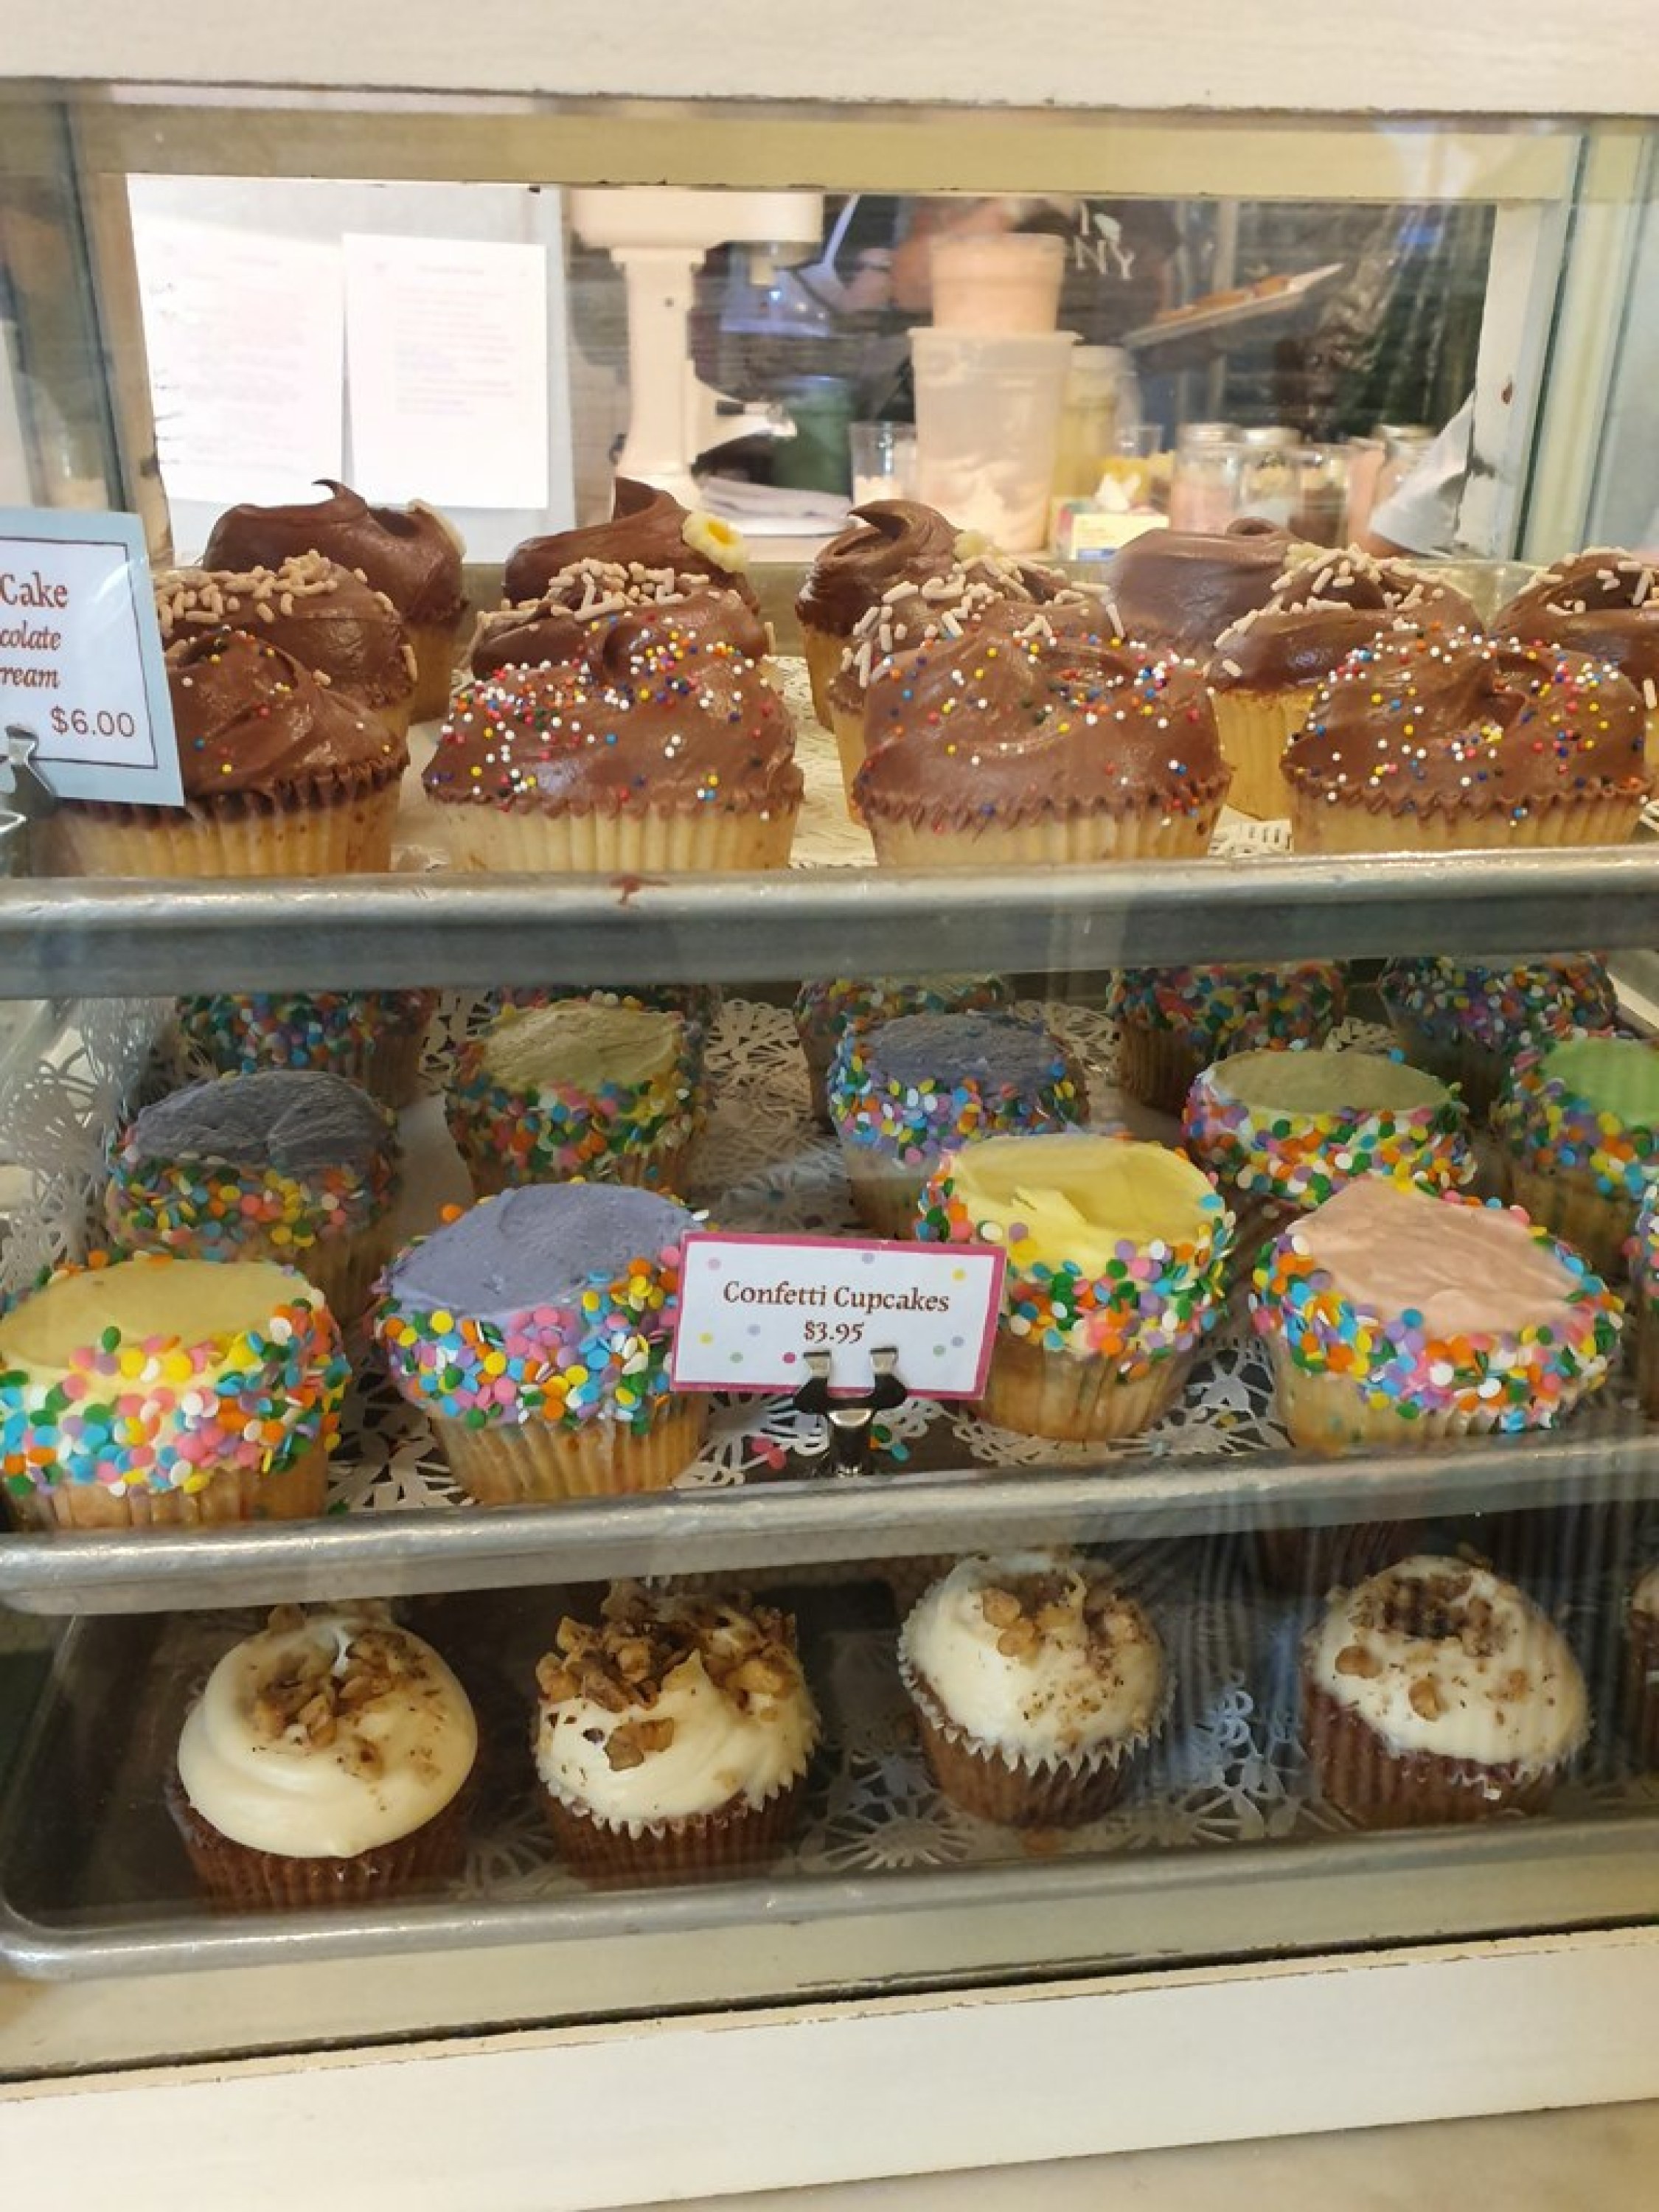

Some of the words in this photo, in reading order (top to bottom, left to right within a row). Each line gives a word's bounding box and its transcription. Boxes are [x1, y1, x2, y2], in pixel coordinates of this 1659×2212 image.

[1074, 235, 1135, 280] NY
[0, 570, 68, 608] Cake
[0, 619, 61, 650] colate
[50, 706, 135, 737] $6.00
[723, 1281, 827, 1307] Confetti
[833, 1287, 950, 1315] Cupcakes
[804, 1320, 865, 1344] $3.95
